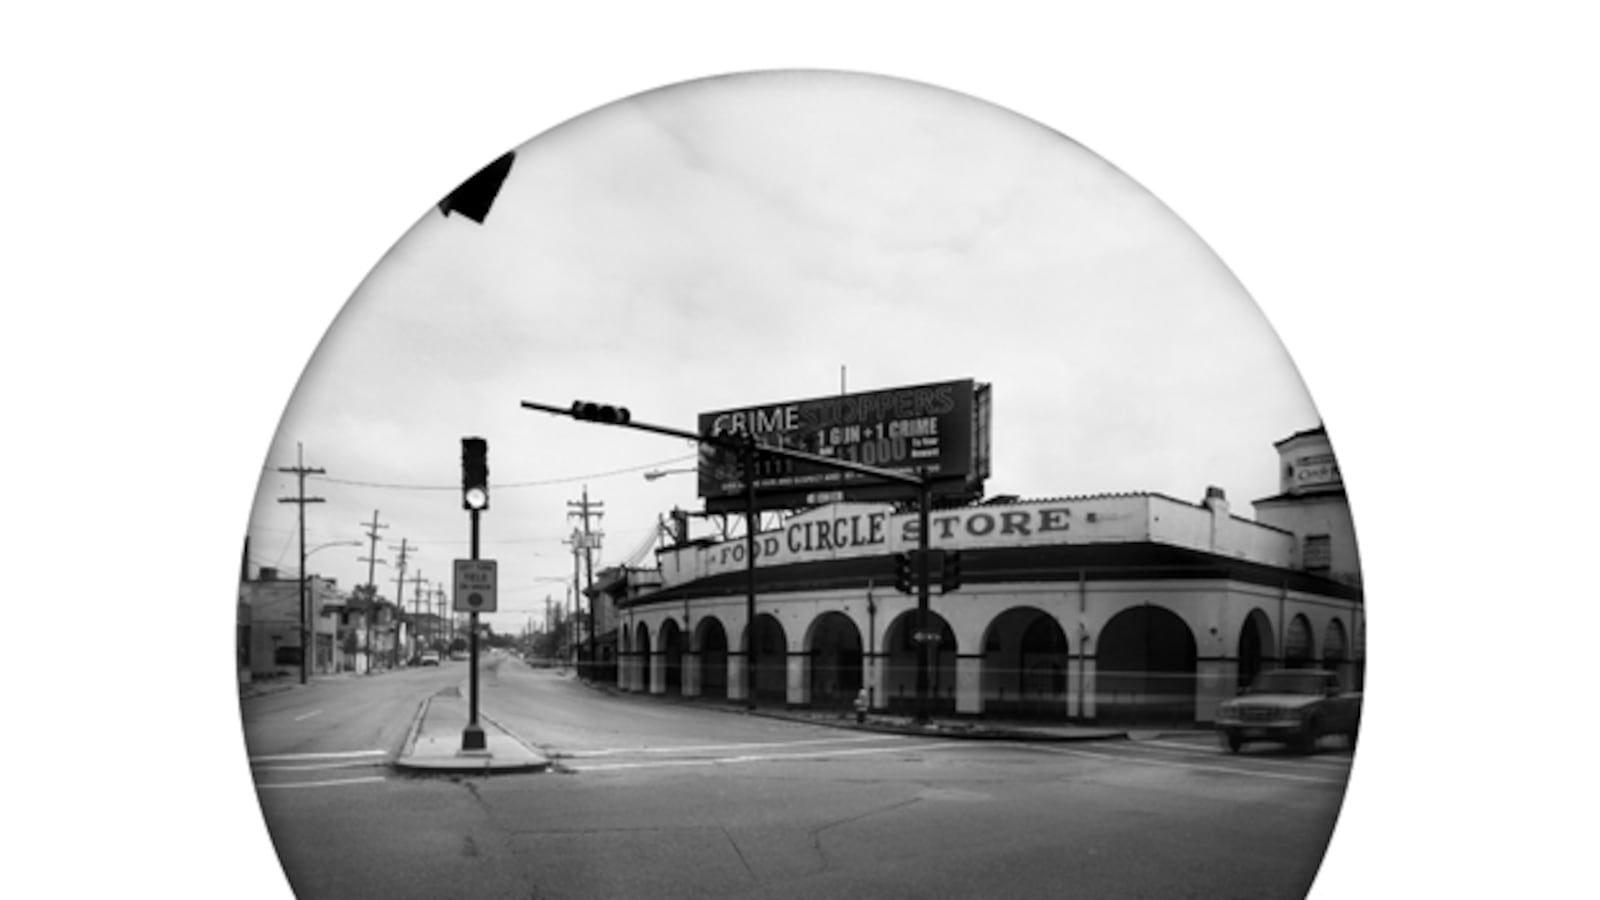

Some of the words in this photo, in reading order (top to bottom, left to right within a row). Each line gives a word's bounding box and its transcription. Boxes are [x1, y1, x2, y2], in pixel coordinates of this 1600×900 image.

[711, 405, 799, 437] CRIME
[800, 386, 954, 425] STOPPERS
[888, 416, 938, 439] CRIME
[720, 538, 779, 565] FOOD
[787, 512, 885, 553] CIRCLE
[902, 508, 1071, 542] STORE
